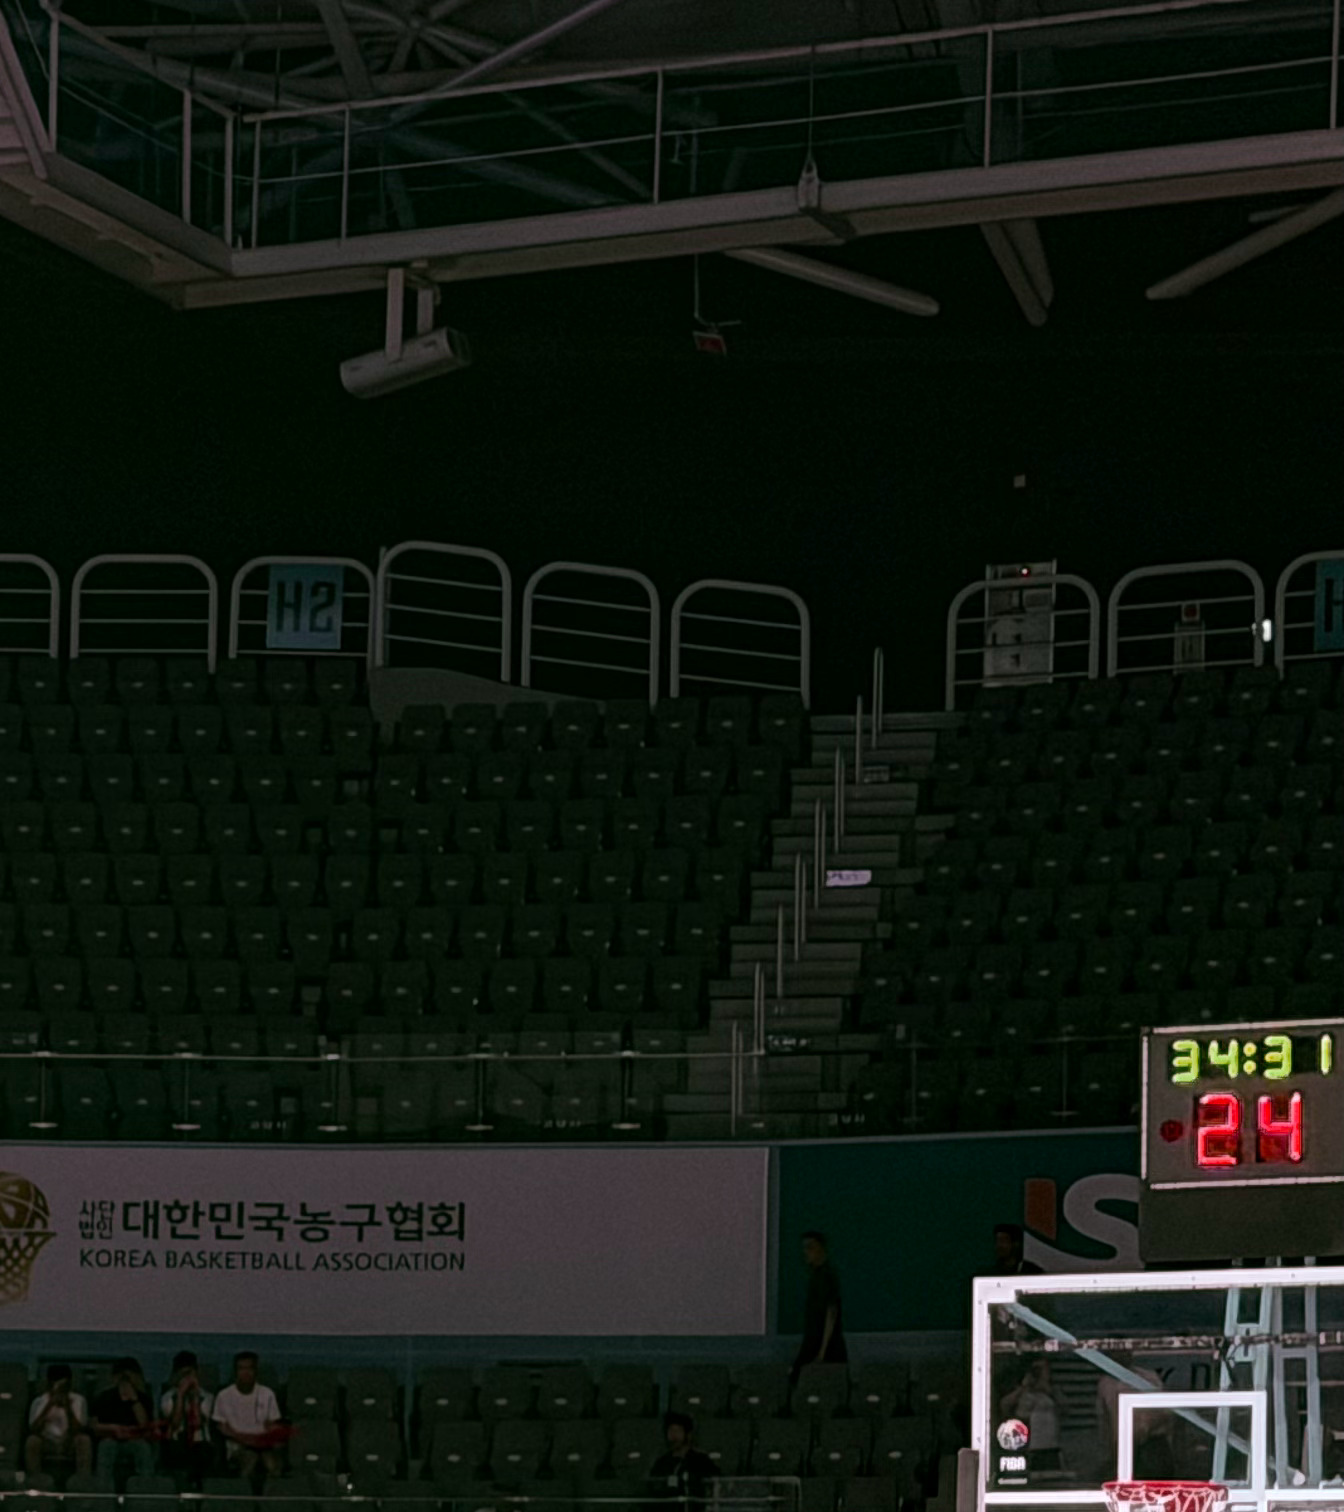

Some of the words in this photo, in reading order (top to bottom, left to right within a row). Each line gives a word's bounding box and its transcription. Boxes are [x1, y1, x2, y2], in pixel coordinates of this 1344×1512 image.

[275, 580, 336, 634] H2
[1195, 1091, 1303, 1167] 24
[123, 1200, 465, 1242] 대한민국농구협회
[79, 1249, 157, 1269] KOREA
[166, 1250, 306, 1271] BASKETBALL
[312, 1251, 465, 1271] ASSOCIATION
[999, 1456, 1027, 1472] FIBA
